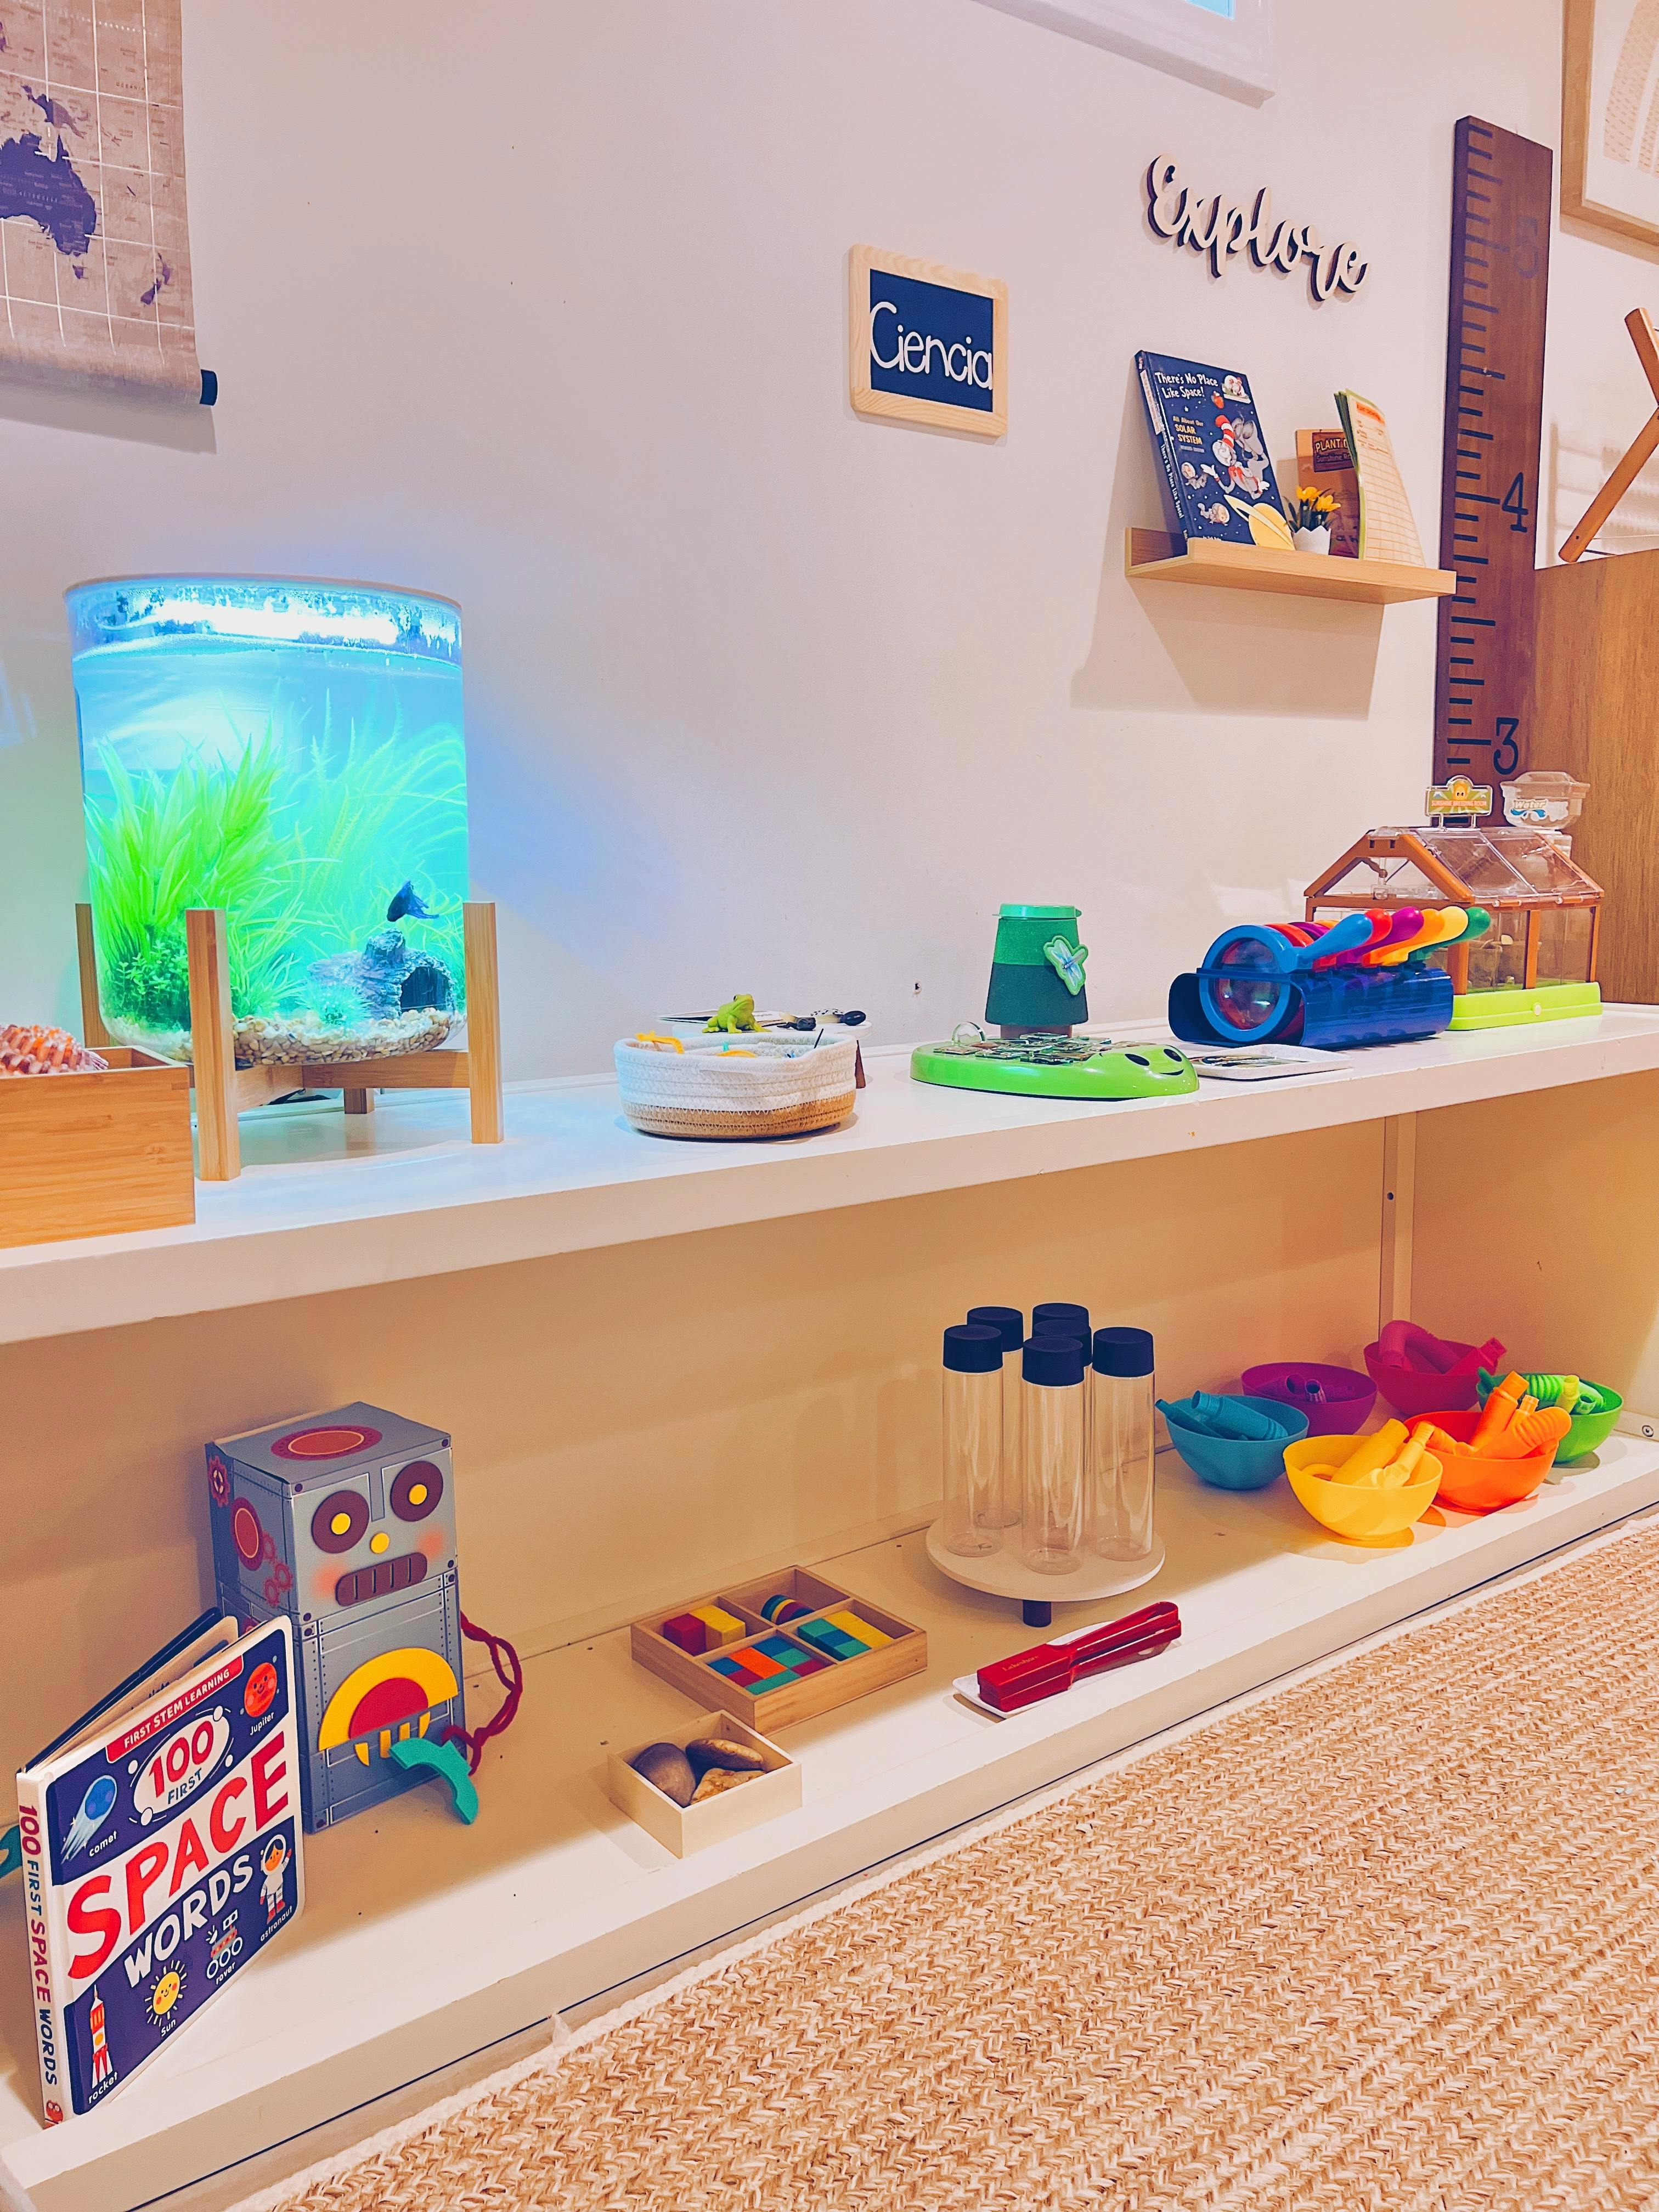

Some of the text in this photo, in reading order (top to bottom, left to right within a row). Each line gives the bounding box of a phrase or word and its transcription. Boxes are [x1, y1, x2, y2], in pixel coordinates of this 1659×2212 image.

[1147, 153, 1369, 302] Explore
[869, 301, 993, 390] Ciencia
[1154, 371, 1218, 387] There's No Place
[1161, 386, 1204, 399] Like Space!
[1175, 424, 1196, 435] SOLAR
[1177, 434, 1203, 445] SYSTEM
[1316, 438, 1340, 453] PLANT
[1501, 471, 1528, 533] 4
[1493, 716, 1519, 775] 3
[1514, 799, 1548, 810] Water
[123, 1723, 151, 1749] FIRST
[153, 1700, 183, 1728] STEM
[184, 1668, 230, 1706] LEARNING
[250, 1712, 274, 1735] Jupiter
[149, 1720, 214, 1798] 100
[168, 1768, 202, 1804] FIRST
[67, 1730, 290, 1979] SPACE
[89, 1831, 117, 1857] comet
[124, 1854, 253, 1988] WORDS
[260, 1905, 292, 1942] astronaut
[19, 1805, 57, 2085] 100 FIRST SPACE WORDS
[216, 1962, 235, 1985] rover
[88, 2072, 118, 2104] rocket
